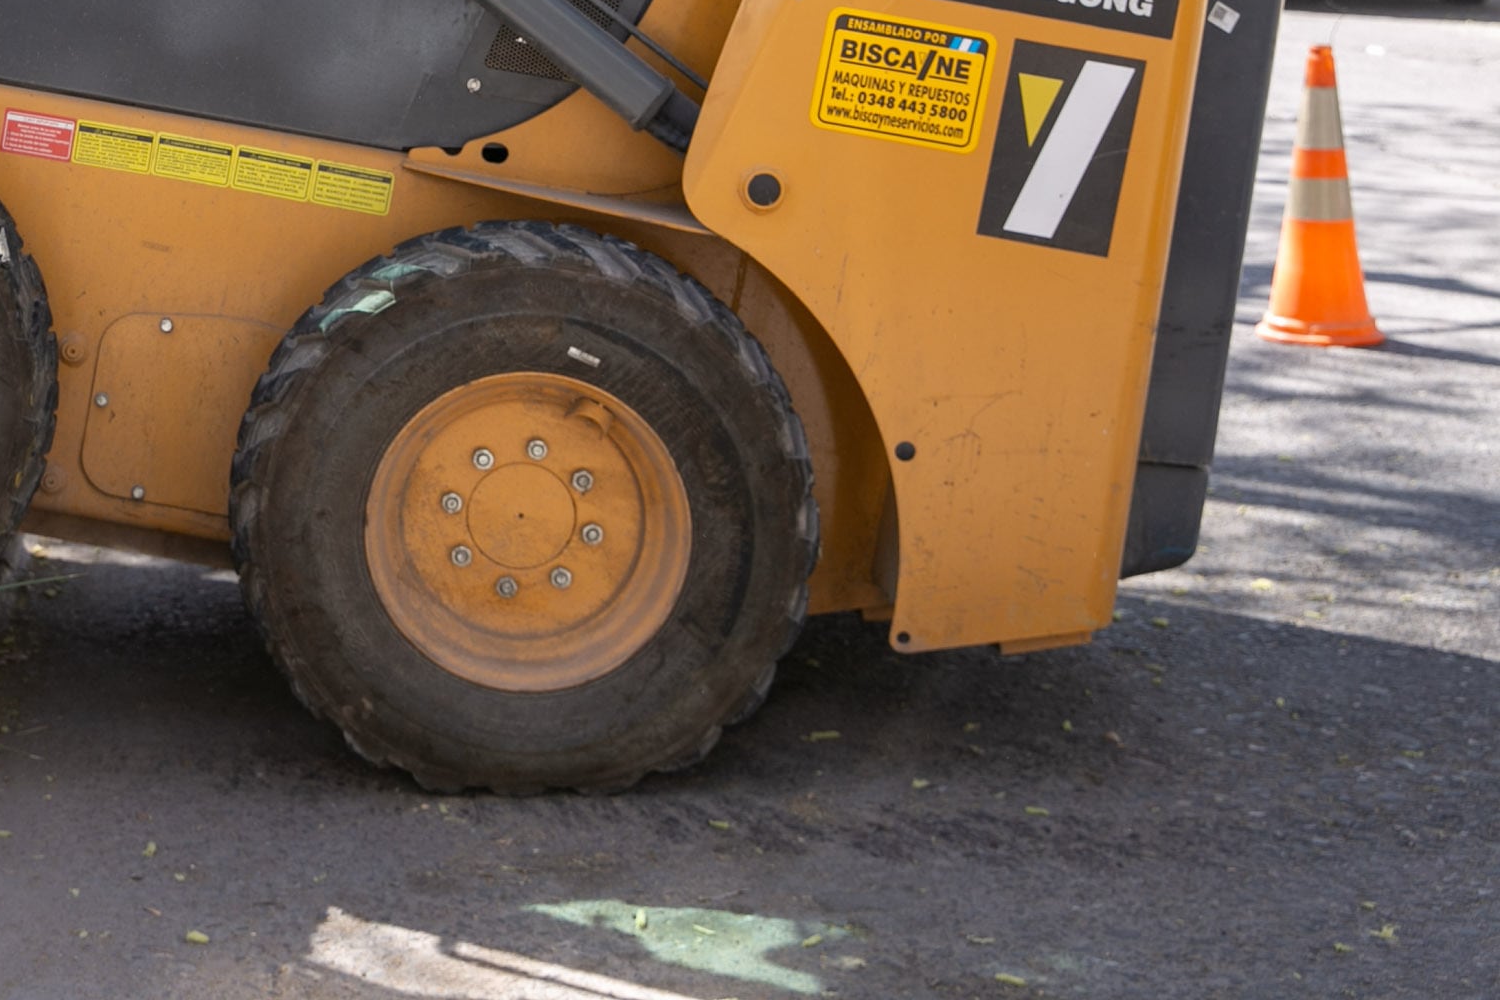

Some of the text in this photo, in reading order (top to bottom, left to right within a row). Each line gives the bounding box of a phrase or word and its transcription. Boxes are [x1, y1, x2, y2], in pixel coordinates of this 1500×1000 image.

[847, 18, 948, 45] ENSAMBLADO POR
[831, 86, 967, 122] Tel.: 0348 443 5800
[833, 70, 970, 106] MAQUINAS Y REPUESTOS
[826, 104, 964, 139] www.biscayneservicios.com
